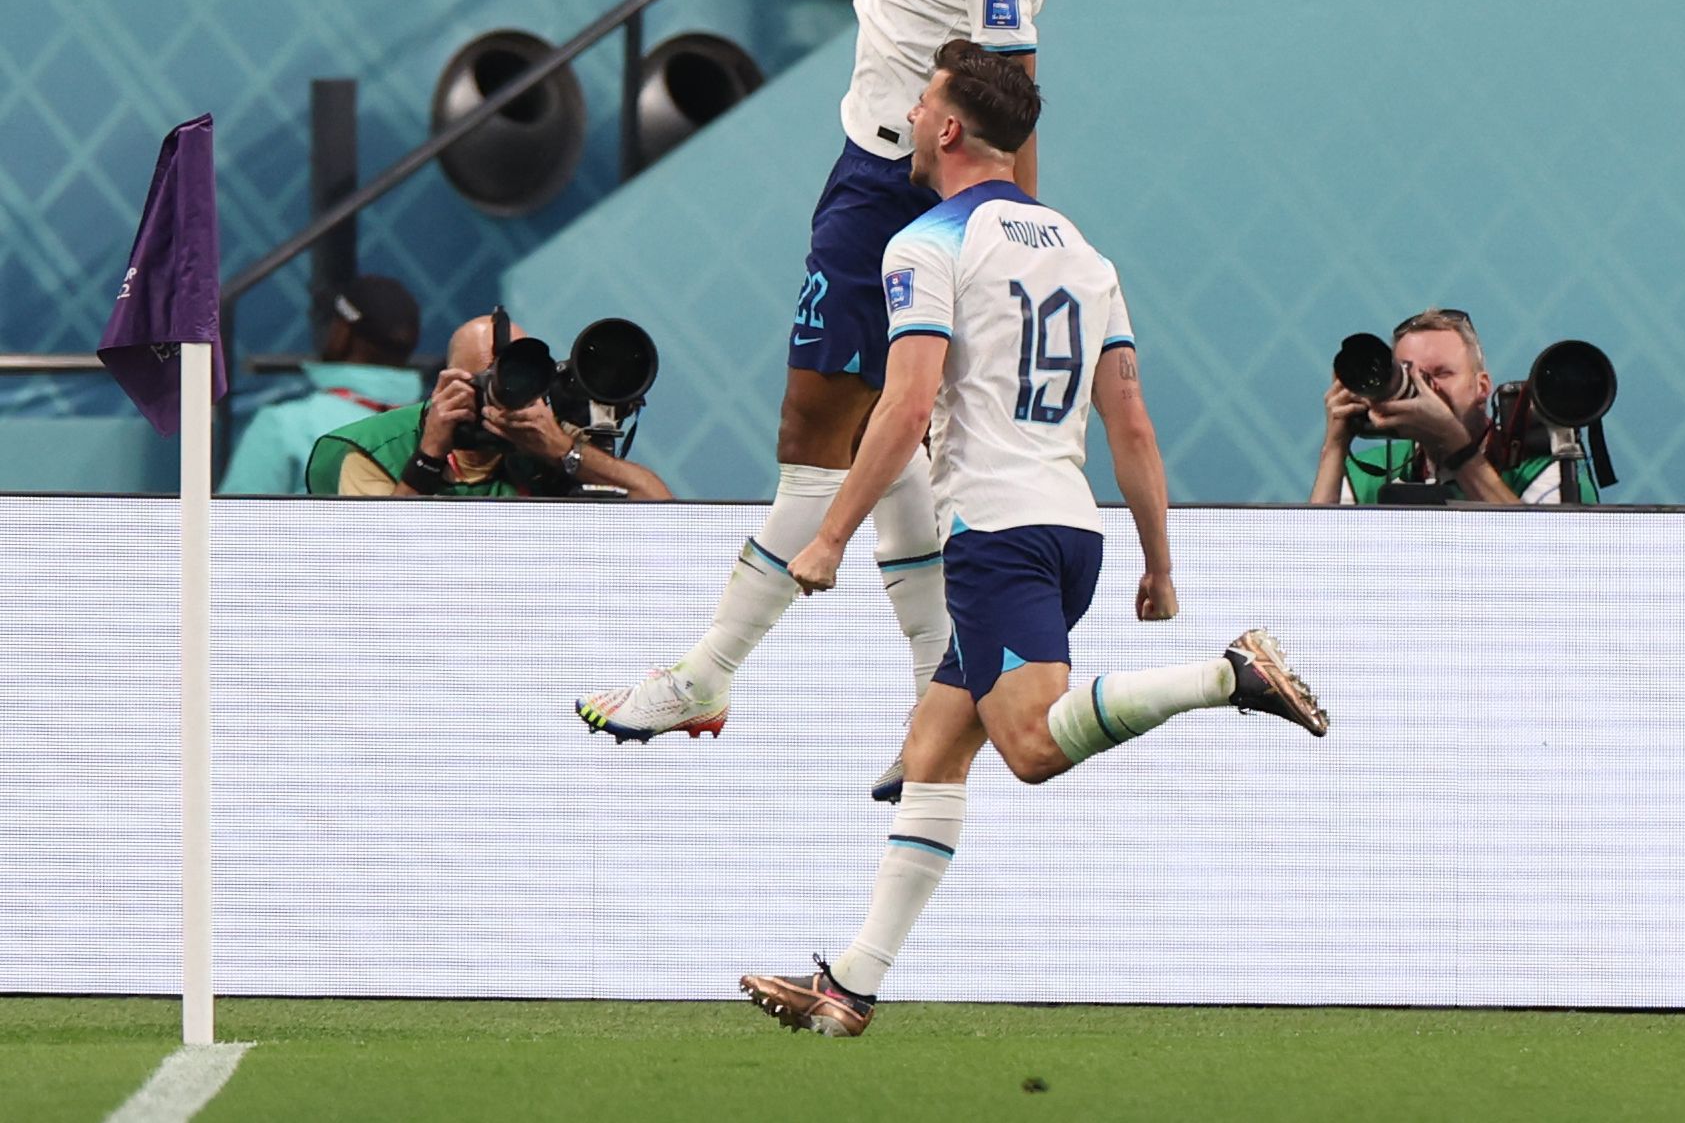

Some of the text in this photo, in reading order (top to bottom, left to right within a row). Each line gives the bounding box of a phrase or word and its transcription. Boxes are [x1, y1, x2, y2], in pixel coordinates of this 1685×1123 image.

[998, 216, 1064, 249] MOUNT
[794, 270, 829, 329] 22
[1008, 279, 1083, 425] 19
